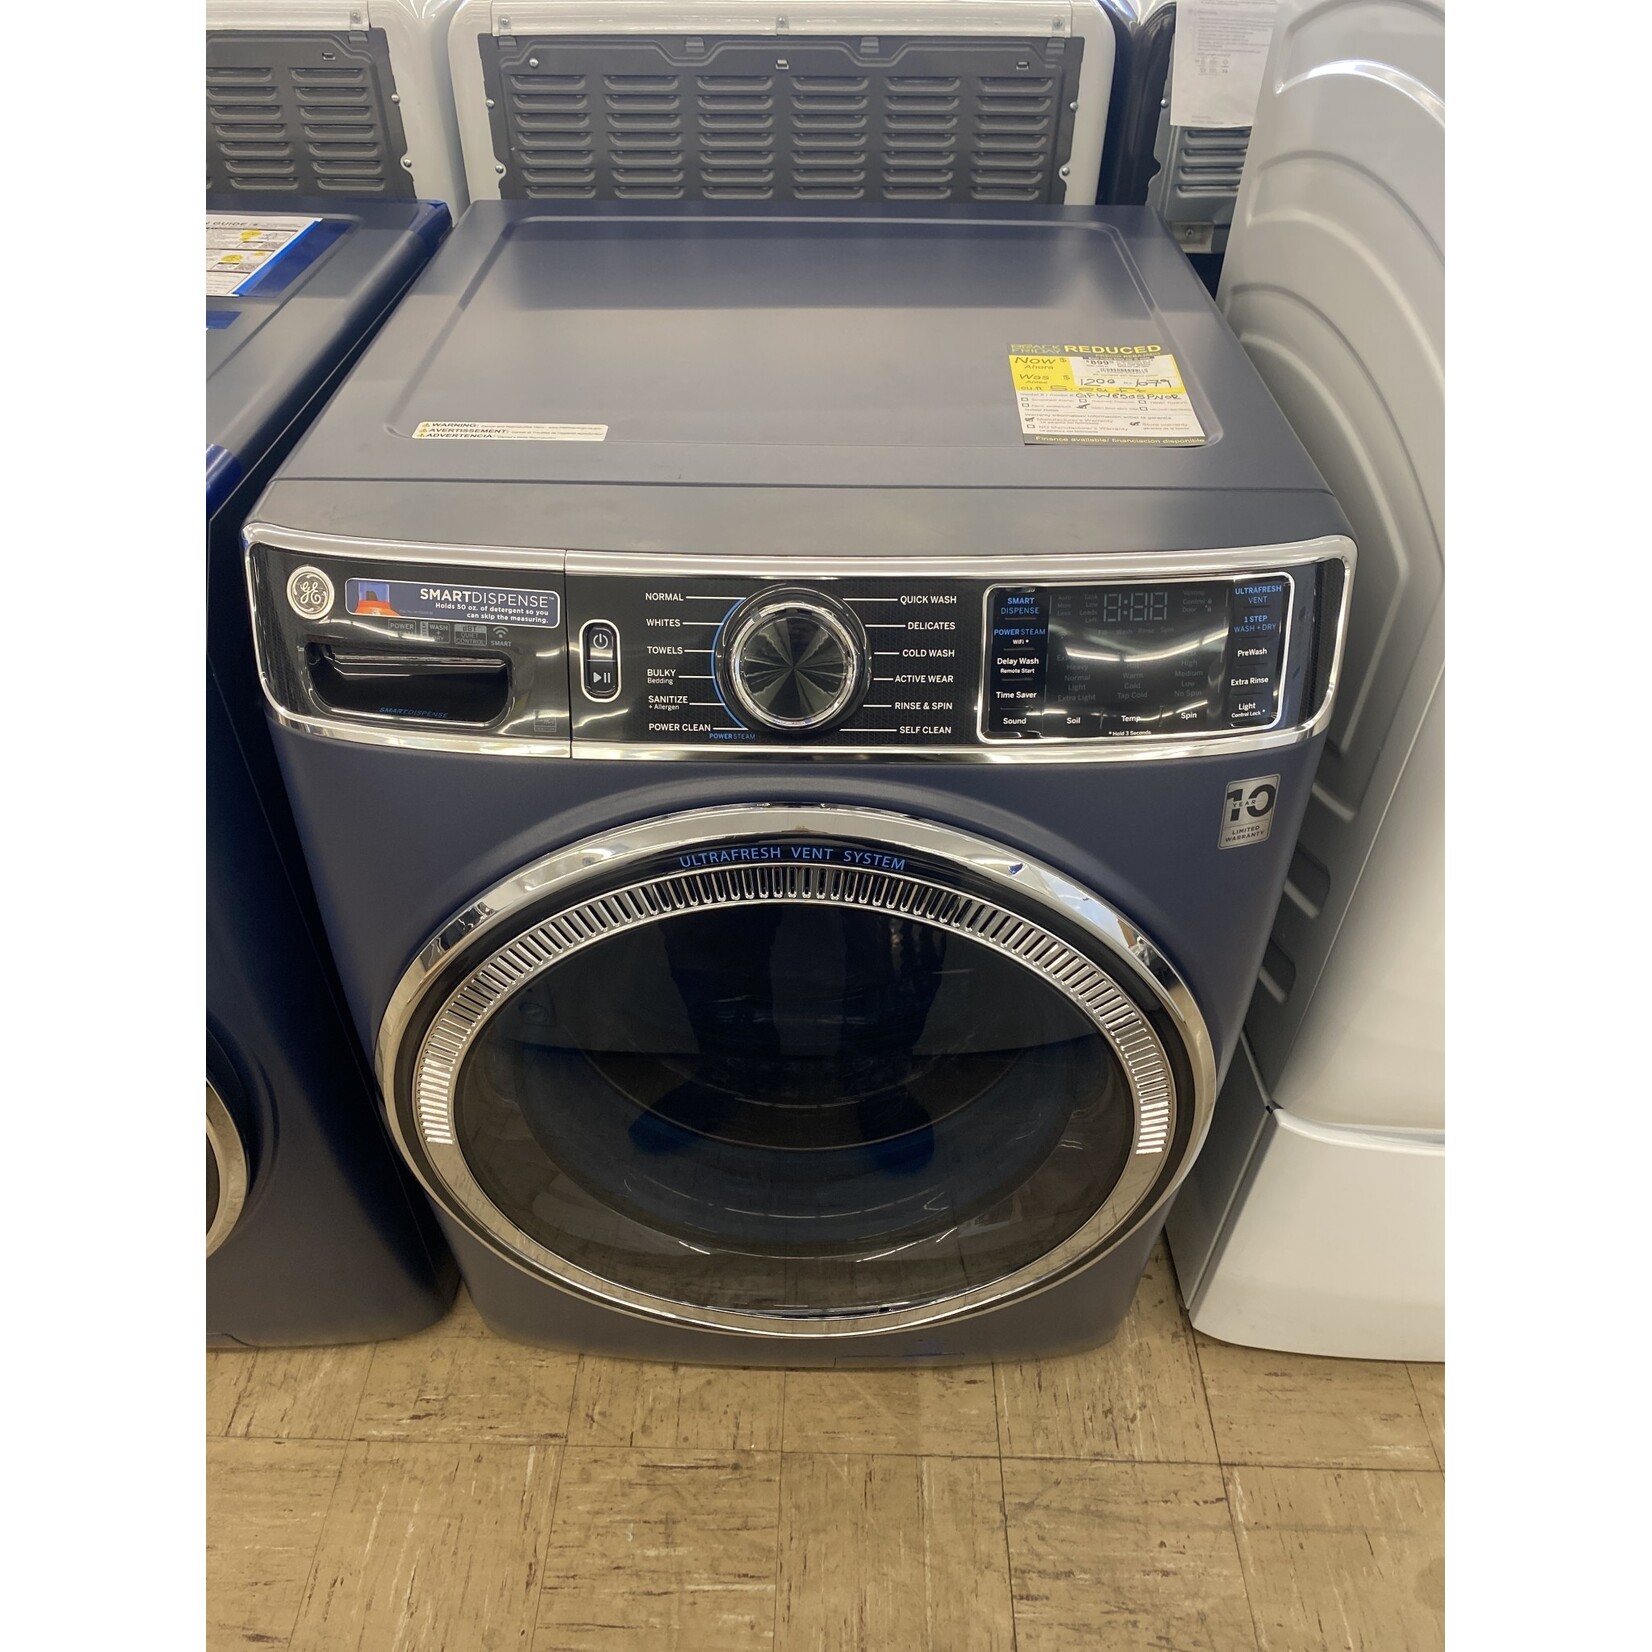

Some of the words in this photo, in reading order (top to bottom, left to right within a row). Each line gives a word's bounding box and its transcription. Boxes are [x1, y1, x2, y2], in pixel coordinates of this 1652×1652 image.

[1063, 344, 1161, 355] REDUCED
[1235, 585, 1282, 595] ULTRAFRESH
[645, 592, 684, 601] NORMAL
[900, 595, 928, 605] QUICK
[930, 595, 957, 604] WASH
[1007, 597, 1035, 605] SMART
[1248, 596, 1268, 604] VENT
[435, 602, 455, 610] Holds
[489, 606, 525, 616] detergent
[535, 609, 549, 617] you
[1000, 607, 1040, 615] DISPENSE
[480, 611, 495, 620] skip
[510, 614, 549, 624] measuring.
[1249, 615, 1268, 623] STEP
[390, 622, 414, 630] POWER
[646, 618, 681, 627] WHITES
[907, 621, 956, 630] DELICATES
[1234, 625, 1255, 633] WASH
[1262, 623, 1277, 631] DRY
[647, 646, 683, 654] TOWELS
[902, 649, 927, 657] COLD
[928, 649, 955, 657] WASH
[1237, 647, 1268, 657] PreWash
[997, 657, 1018, 666] Delay
[1019, 657, 1040, 665] Wash
[1181, 659, 1198, 668] High
[1067, 663, 1089, 672] Heavy
[647, 668, 676, 677] BULKY
[1174, 670, 1204, 678] Medium
[647, 677, 673, 685] Bedding
[894, 675, 926, 683] ACTIVE
[928, 675, 954, 683] WEAR
[1231, 678, 1249, 686] Extra
[1250, 676, 1269, 685] Rinse
[1067, 683, 1087, 691] Light
[1124, 682, 1141, 690] Cold
[1181, 680, 1196, 688] Low
[996, 691, 1015, 699] Time
[1016, 691, 1037, 699] Saver
[1057, 694, 1076, 702] Extra
[1078, 693, 1096, 701] Light
[1117, 692, 1130, 700] Tap
[1131, 692, 1148, 700] Cold
[1174, 690, 1184, 698] No
[1186, 689, 1203, 698] Spin
[648, 695, 688, 704] SANITIZE
[894, 701, 921, 710] RINSE
[922, 702, 930, 710] &
[931, 702, 953, 710] SPIN
[1238, 702, 1256, 711] Light
[379, 706, 449, 718] SMARTDISPENSE
[1180, 712, 1198, 721] Spin
[1066, 716, 1081, 725] Soil
[1121, 715, 1141, 725] Temp
[648, 723, 680, 731] POWER
[682, 724, 711, 732] CLEAN
[899, 725, 921, 734] SELF
[922, 726, 952, 734] CLEAN
[1227, 784, 1277, 822] 10
[1232, 800, 1256, 808] YEAR
[1232, 825, 1260, 835] LIMITED
[1225, 830, 1264, 842] WARRANTY
[679, 847, 781, 868] ULTRAFRESH
[791, 847, 834, 859] VENT
[843, 850, 906, 870] SYSTEM
